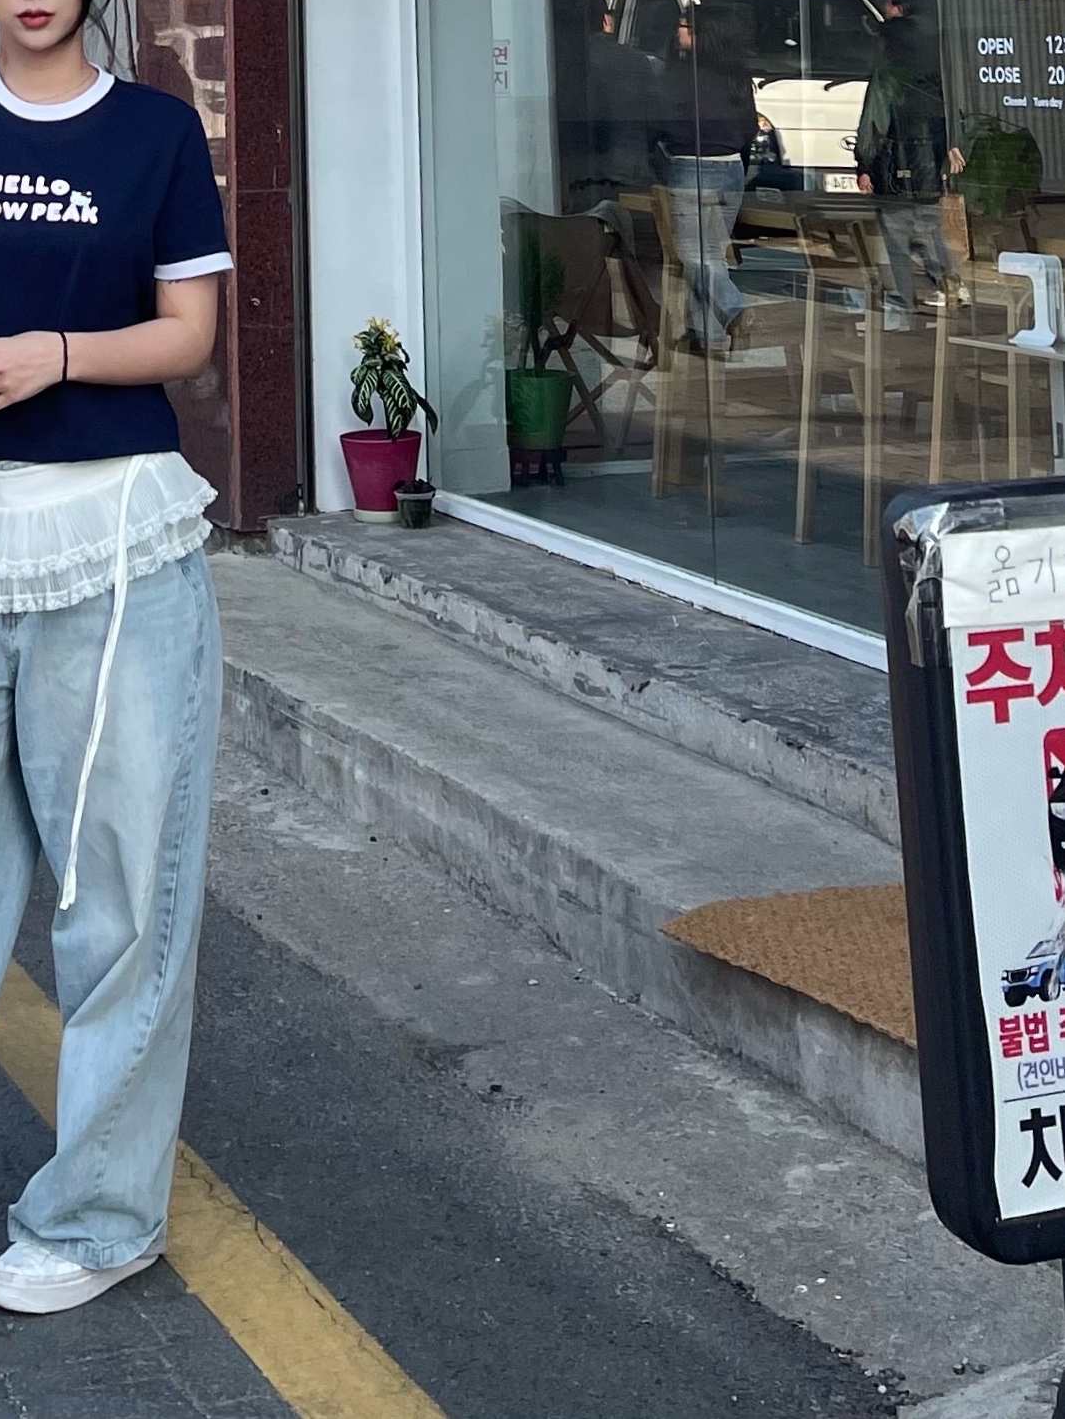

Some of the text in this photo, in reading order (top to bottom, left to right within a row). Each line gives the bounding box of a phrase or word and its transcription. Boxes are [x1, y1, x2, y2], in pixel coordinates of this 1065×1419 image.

[977, 37, 1014, 55] OPEN
[979, 66, 1021, 84] CLOSE
[31, 201, 98, 224] PEAK
[999, 1011, 1050, 1059] 불법
